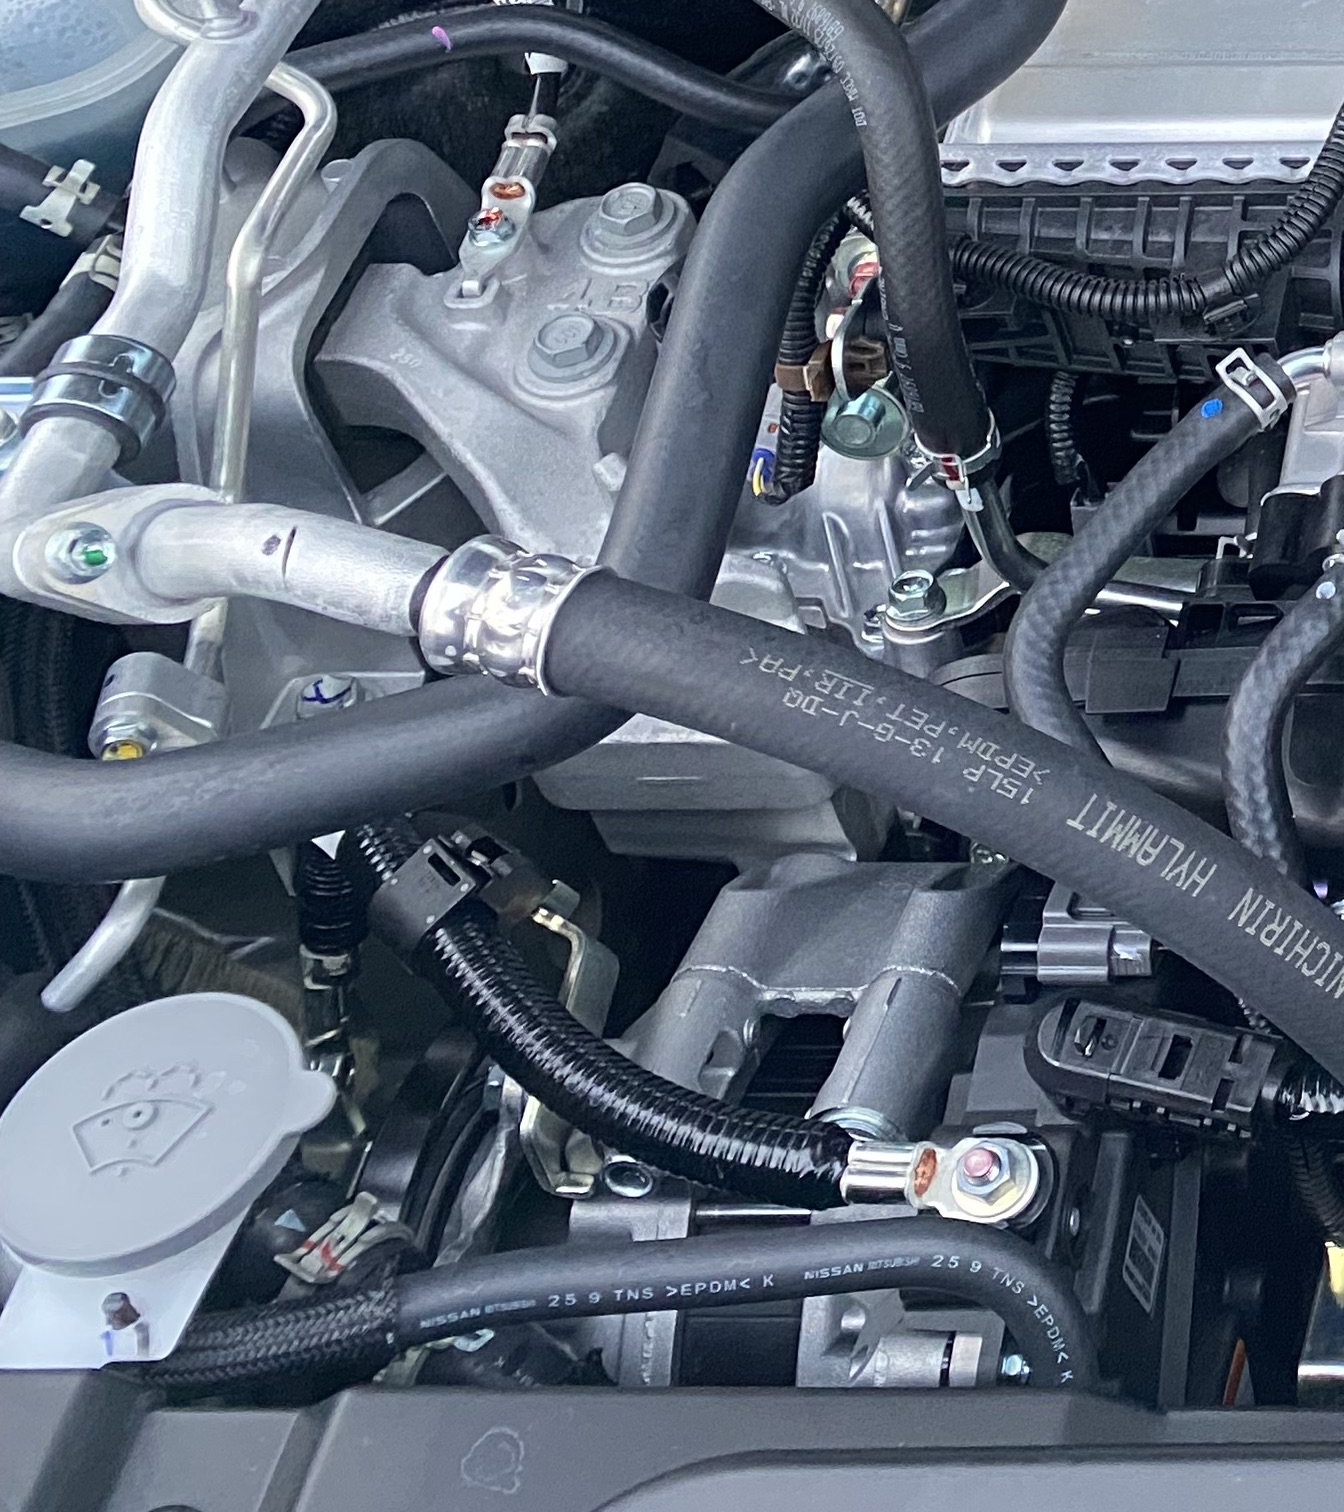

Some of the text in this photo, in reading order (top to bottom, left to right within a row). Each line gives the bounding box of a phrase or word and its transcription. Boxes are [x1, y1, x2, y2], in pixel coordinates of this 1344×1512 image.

[962, 764, 1034, 805] 15LP
[1066, 793, 1218, 897] HYLAMMIT
[420, 1306, 481, 1329] NISSAN
[548, 1294, 577, 1308] 25
[589, 1293, 601, 1305] 9
[614, 1287, 654, 1302] TNS
[665, 1277, 750, 1297] >EPDM<
[763, 1274, 775, 1287] K
[804, 1263, 864, 1281] NISSAN
[931, 1254, 960, 1269] 25
[969, 1260, 982, 1273] 9
[992, 1267, 1025, 1295] TNS
[1026, 1294, 1069, 1364] >EPDM<
[1060, 1369, 1073, 1383] K
